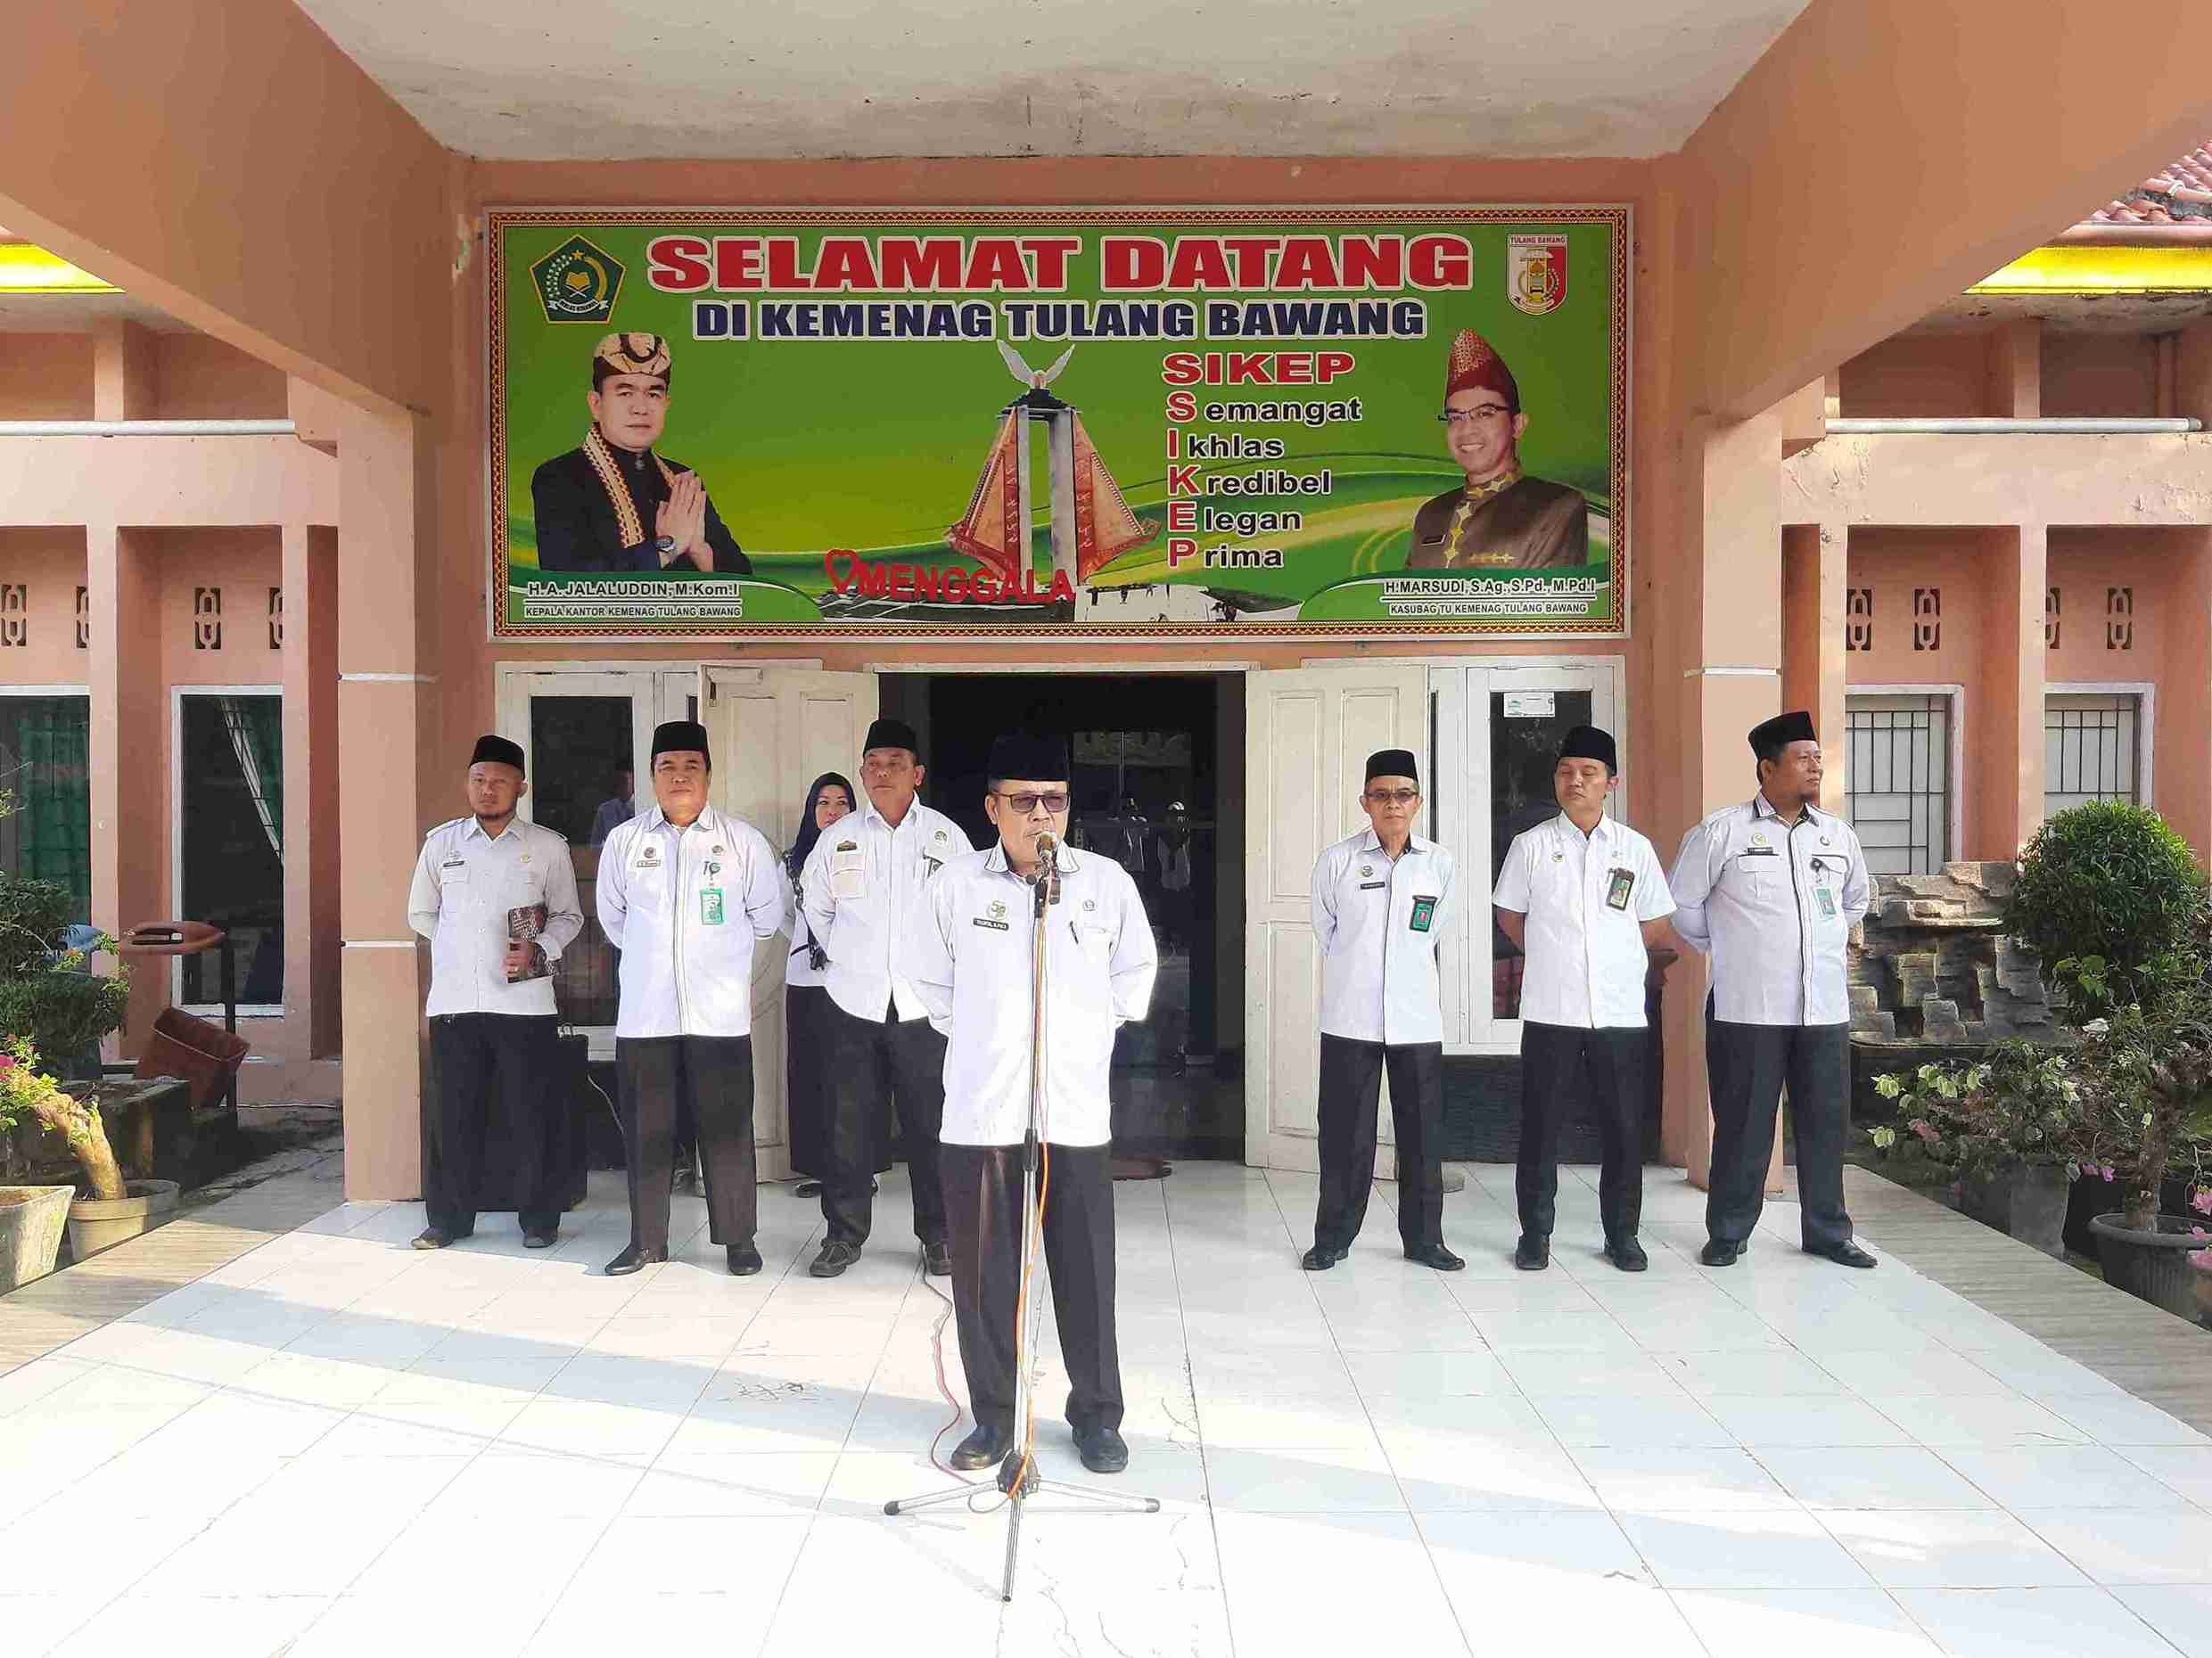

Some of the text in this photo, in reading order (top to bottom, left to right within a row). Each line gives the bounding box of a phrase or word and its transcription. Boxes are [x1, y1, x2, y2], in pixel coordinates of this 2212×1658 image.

[647, 234, 1473, 291] SELAMAT DATANG
[694, 299, 1427, 341] DI KEMENAG TULANG BAWANG
[1162, 352, 1355, 385] SIKEP
[856, 562, 1075, 603] MENGGALA
[526, 606, 741, 617] KEPALA KANTOR KEMENAG TULANG BAWANG
[1390, 603, 1587, 614] KASUBAG TU KEMENAG TULANG BAWANG
